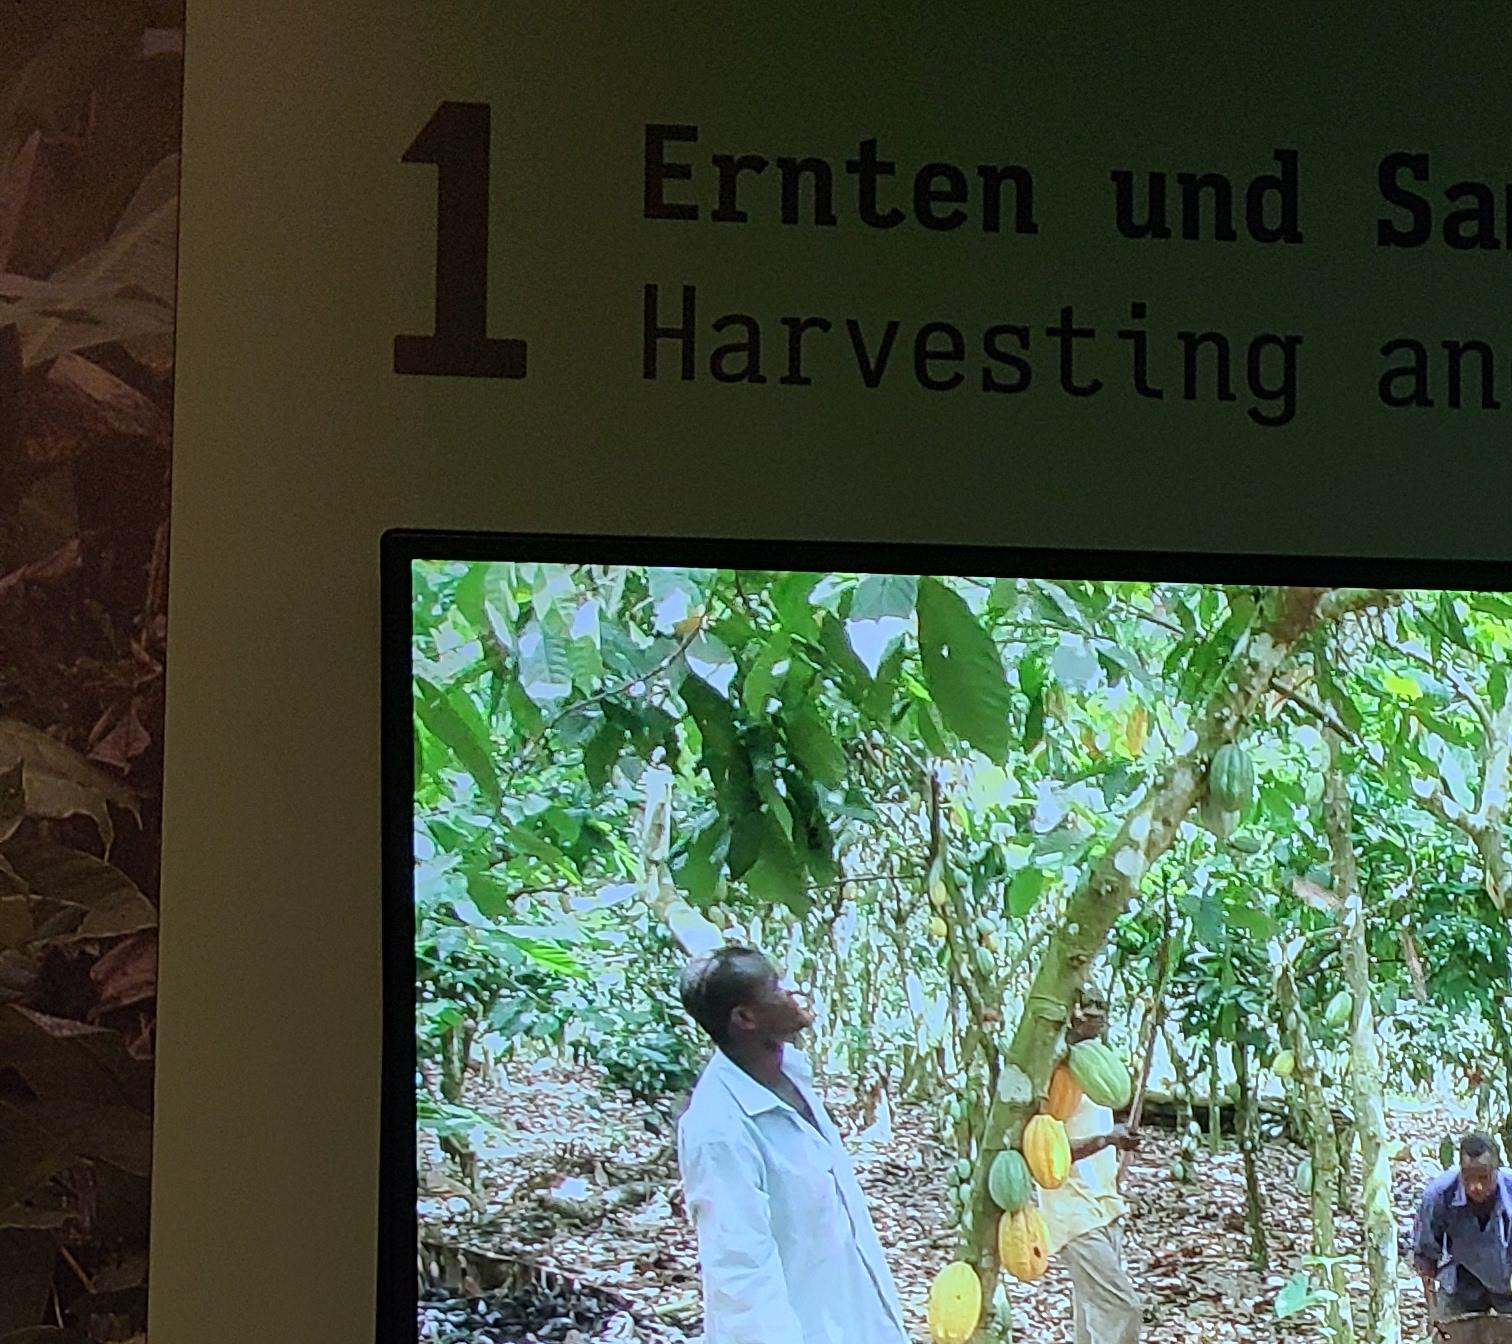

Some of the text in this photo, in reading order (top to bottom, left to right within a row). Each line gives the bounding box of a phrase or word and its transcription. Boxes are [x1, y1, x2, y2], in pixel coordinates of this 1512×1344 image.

[393, 100, 528, 380] 1
[643, 124, 1038, 234] Ernten
[1110, 149, 1303, 244] und
[643, 283, 1303, 427] Harvesting
